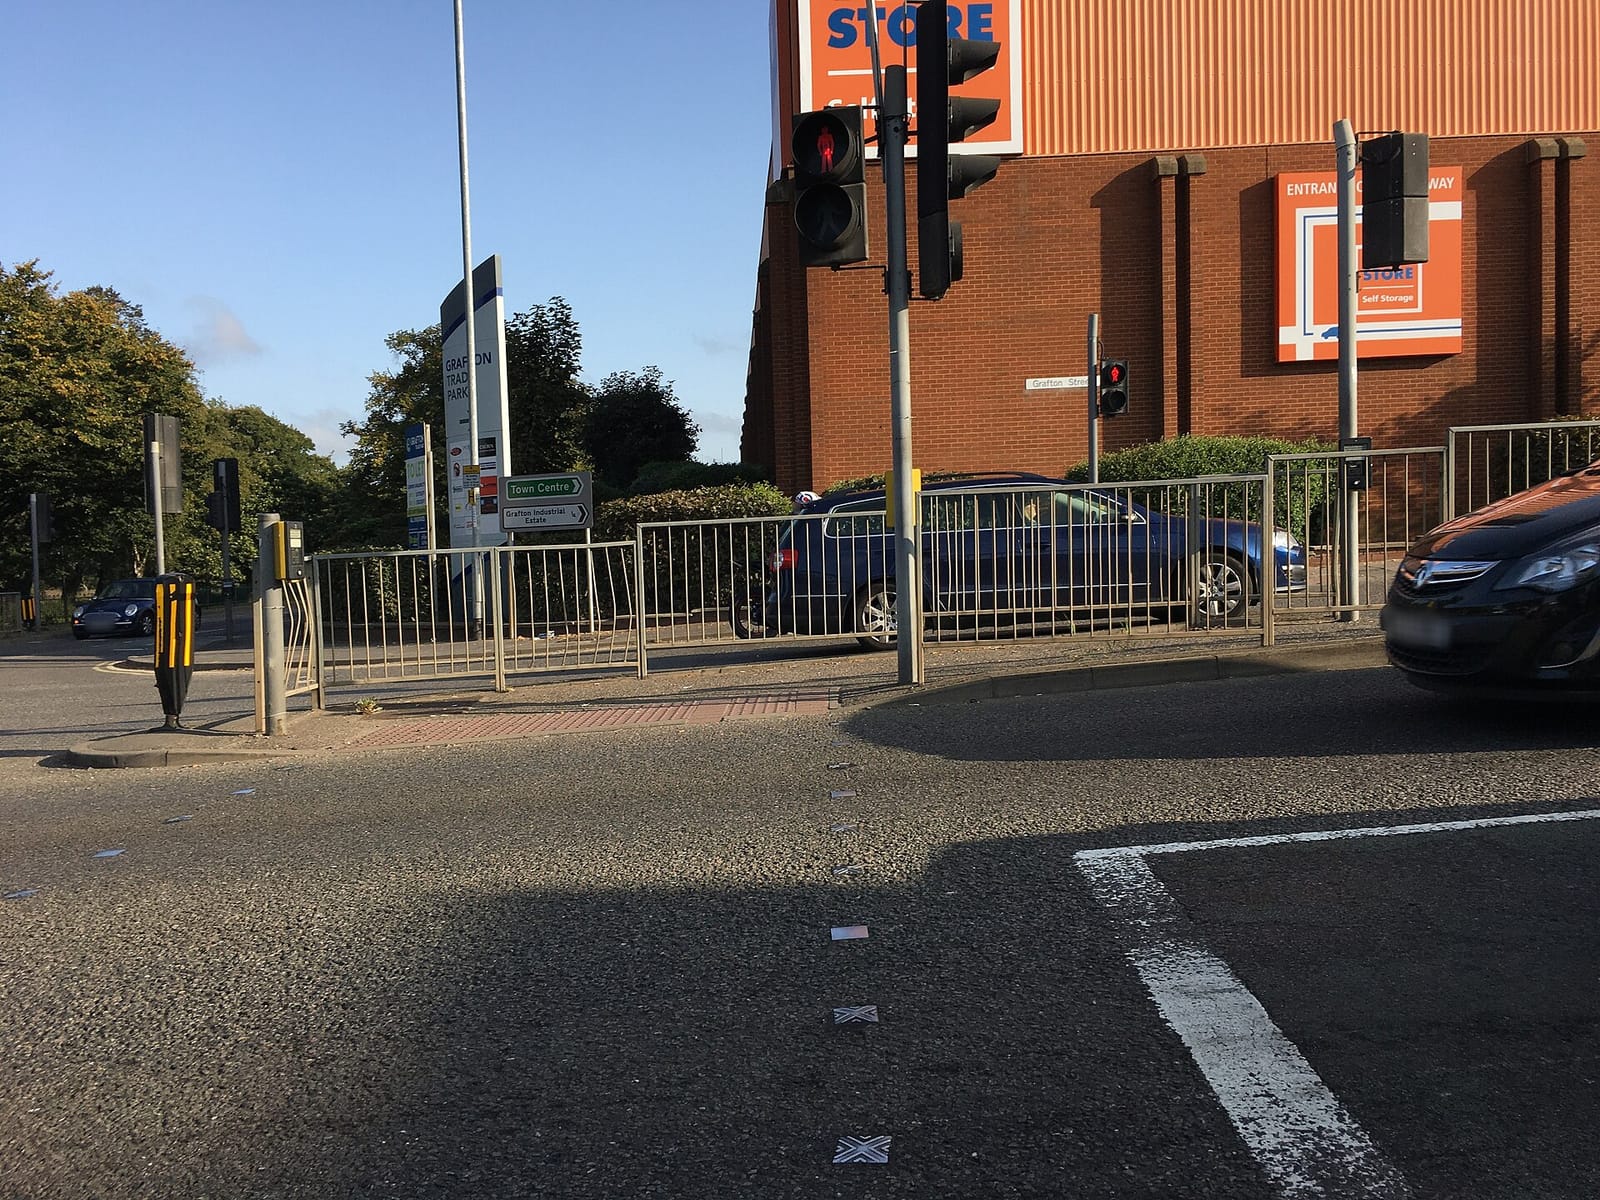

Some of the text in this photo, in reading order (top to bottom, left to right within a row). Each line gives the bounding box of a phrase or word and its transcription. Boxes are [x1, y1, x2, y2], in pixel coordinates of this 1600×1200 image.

[1287, 181, 1337, 196] ENTRAN
[1362, 293, 1414, 303] Self Storage
[446, 352, 492, 372] GRAFON
[446, 371, 469, 387] TRAD
[1032, 377, 1089, 388] Grafton Stree
[510, 482, 570, 494] Town Centre
[505, 506, 566, 518] Grafton Industrial
